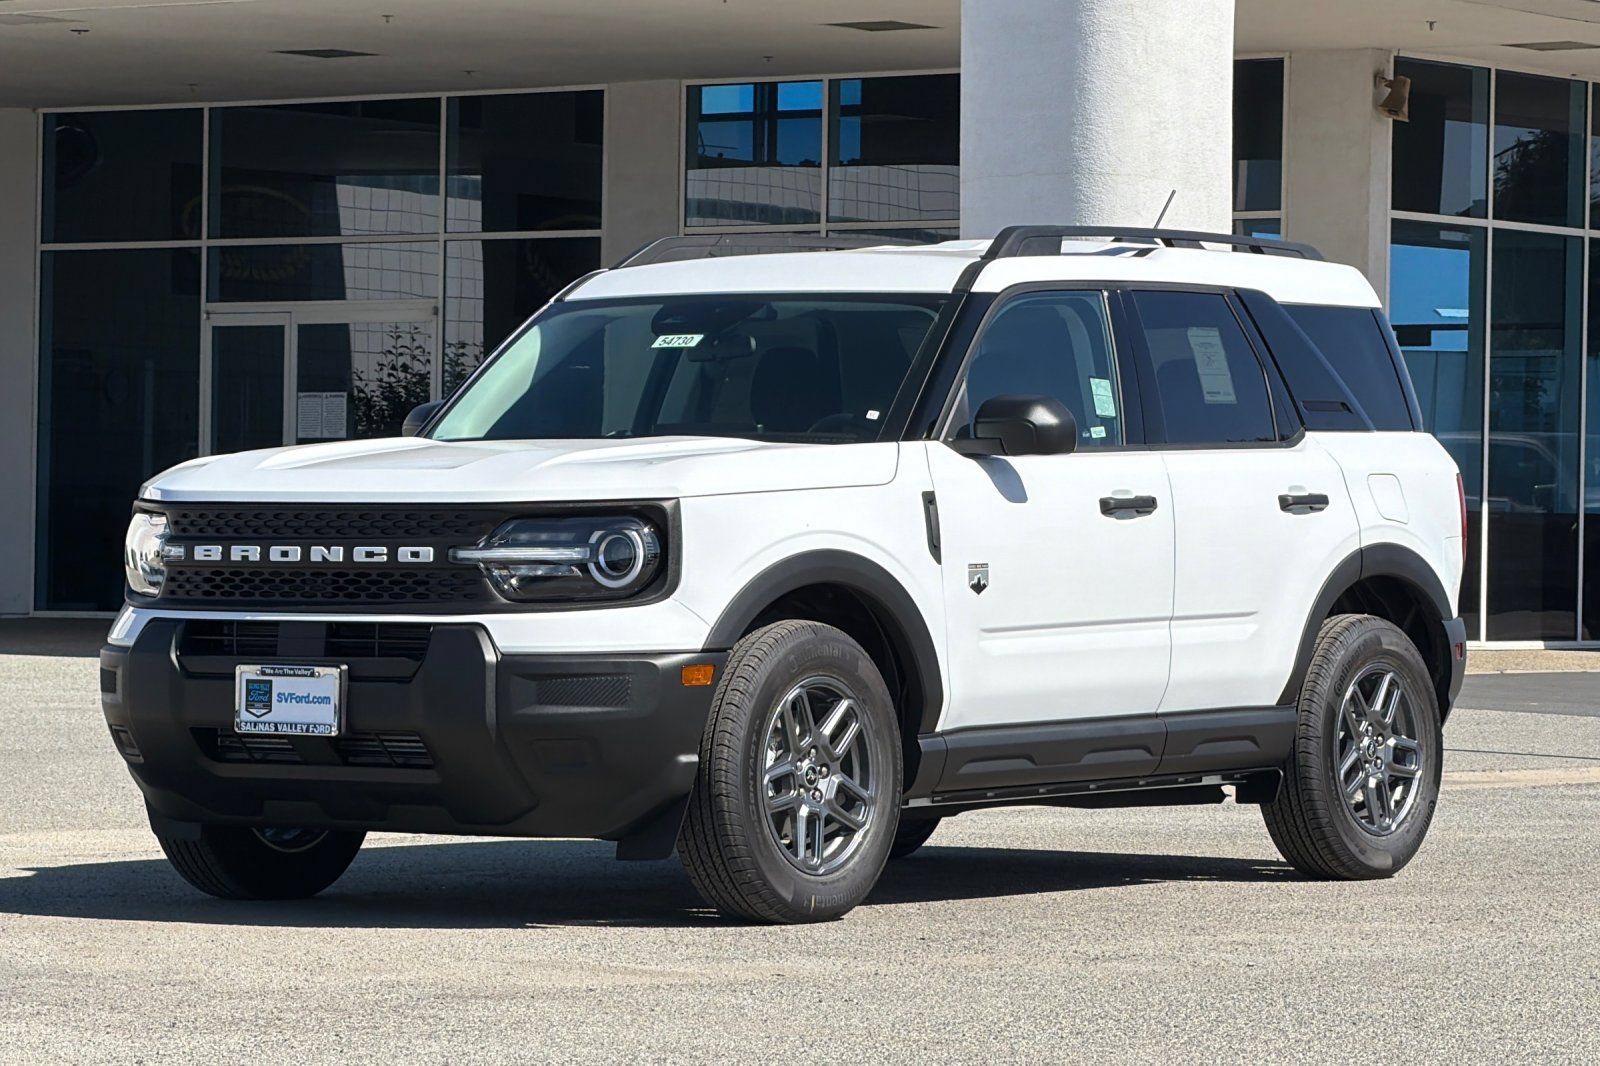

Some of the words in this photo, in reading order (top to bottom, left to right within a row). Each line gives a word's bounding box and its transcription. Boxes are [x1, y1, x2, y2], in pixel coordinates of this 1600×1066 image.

[659, 336, 695, 346] 54730
[193, 545, 434, 562] BRONCO
[249, 690, 270, 702] Ford
[276, 692, 331, 705] SVFord.com
[240, 722, 275, 732] SALINAS
[277, 723, 307, 733] VALLEY
[309, 724, 331, 734] FORD
